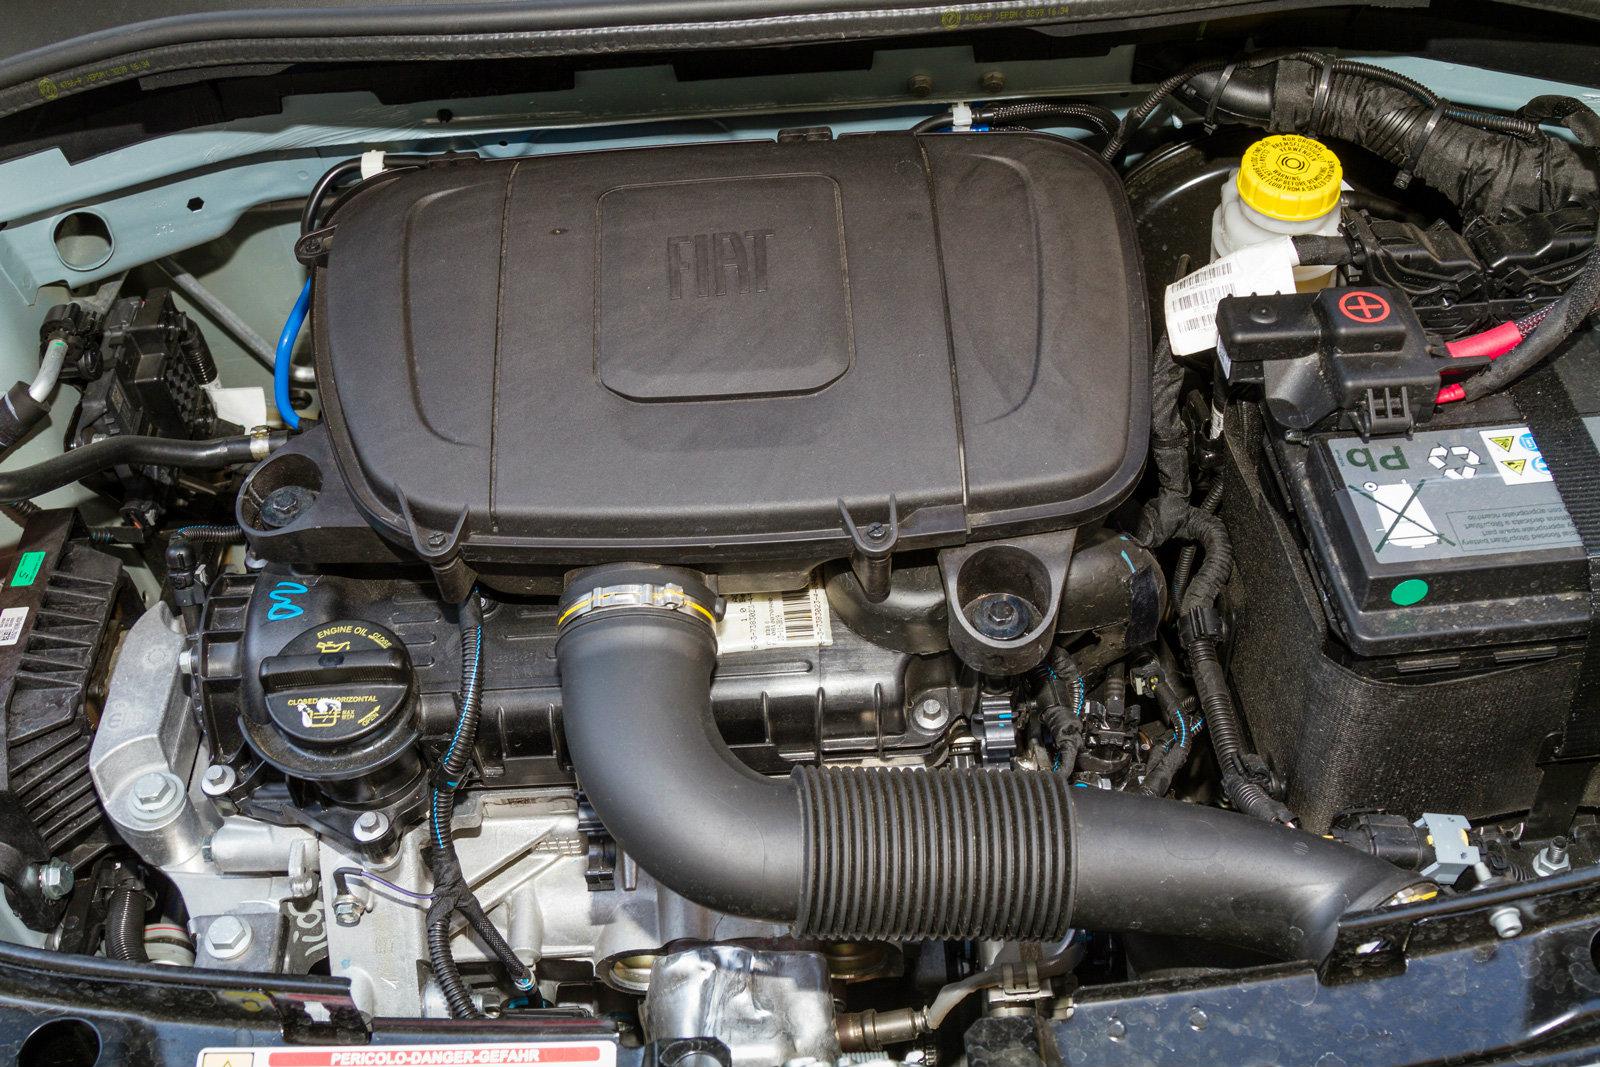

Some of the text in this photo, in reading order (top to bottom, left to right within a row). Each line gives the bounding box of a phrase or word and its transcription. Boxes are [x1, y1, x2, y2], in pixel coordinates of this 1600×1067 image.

[667, 229, 776, 300] FIAT
[1345, 445, 1410, 472] Pb
[317, 625, 368, 640] ENGINE OIL
[372, 632, 393, 647] CLOSE
[288, 697, 318, 706] CLOSED
